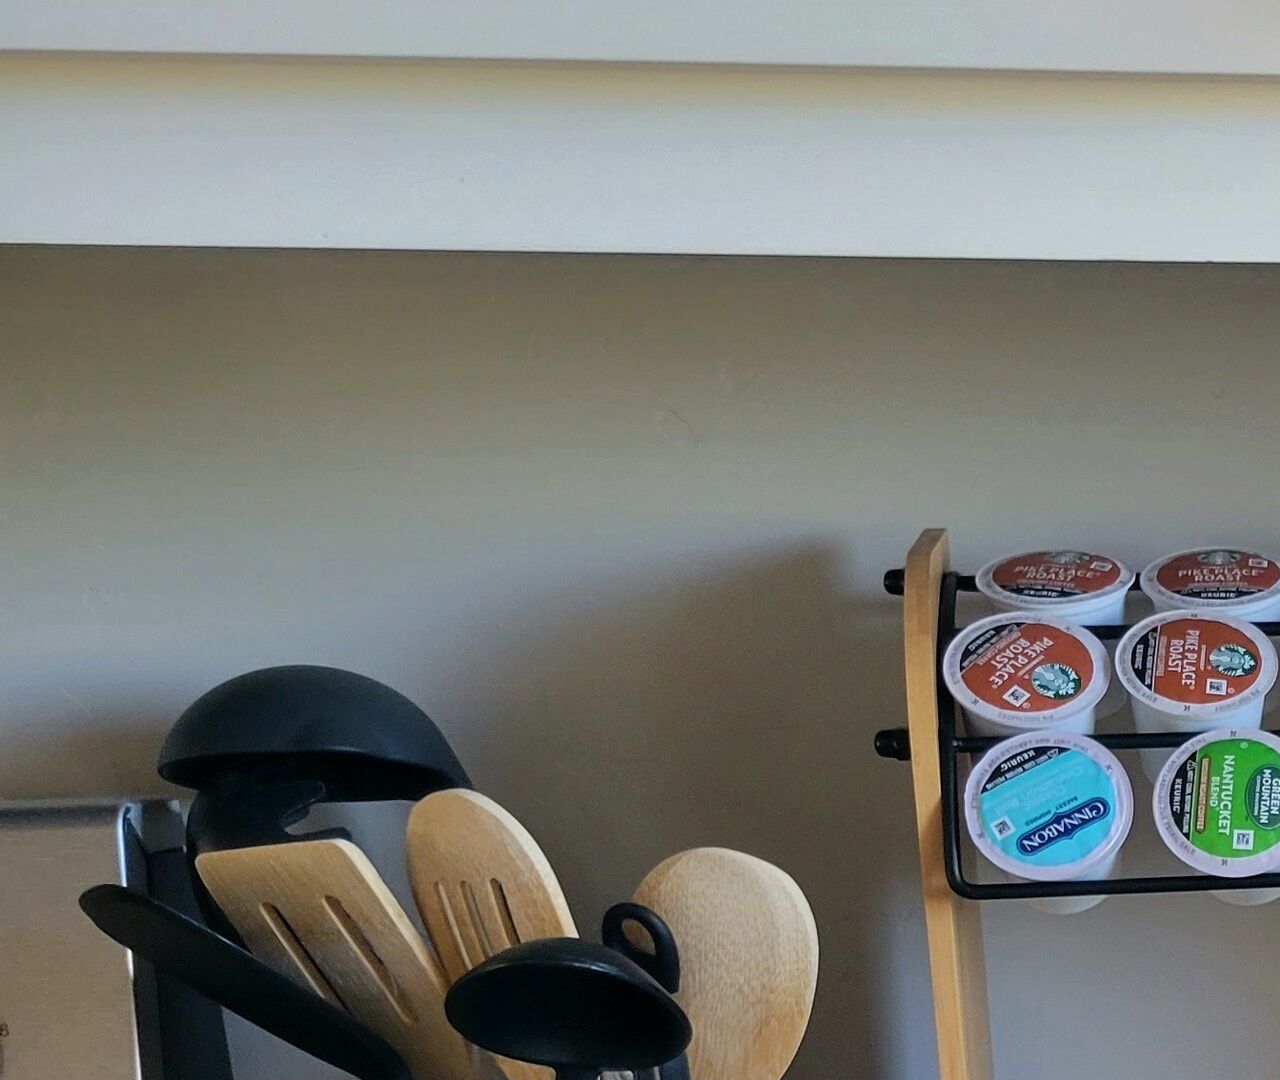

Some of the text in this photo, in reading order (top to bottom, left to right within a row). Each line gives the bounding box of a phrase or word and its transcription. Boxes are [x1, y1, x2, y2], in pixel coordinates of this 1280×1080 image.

[1026, 572, 1073, 581] ROAST
[1053, 567, 1096, 578] PLACE
[1178, 569, 1212, 577] PIKE
[991, 637, 1031, 669] ROAST
[1028, 637, 1054, 658] PIKE
[1168, 639, 1184, 673] ROAST
[1182, 629, 1200, 686] PIKE PLACE
[989, 656, 1029, 687] PLACE
[1001, 750, 1036, 772] KEURIG
[1173, 778, 1183, 814] KEURIG
[1210, 776, 1220, 807] BLEND
[1219, 755, 1235, 836] NANTUCKET
[1260, 769, 1272, 824] MOUNTAIN
[1270, 778, 1280, 814] GREEN
[1022, 802, 1105, 851] CINNABON
